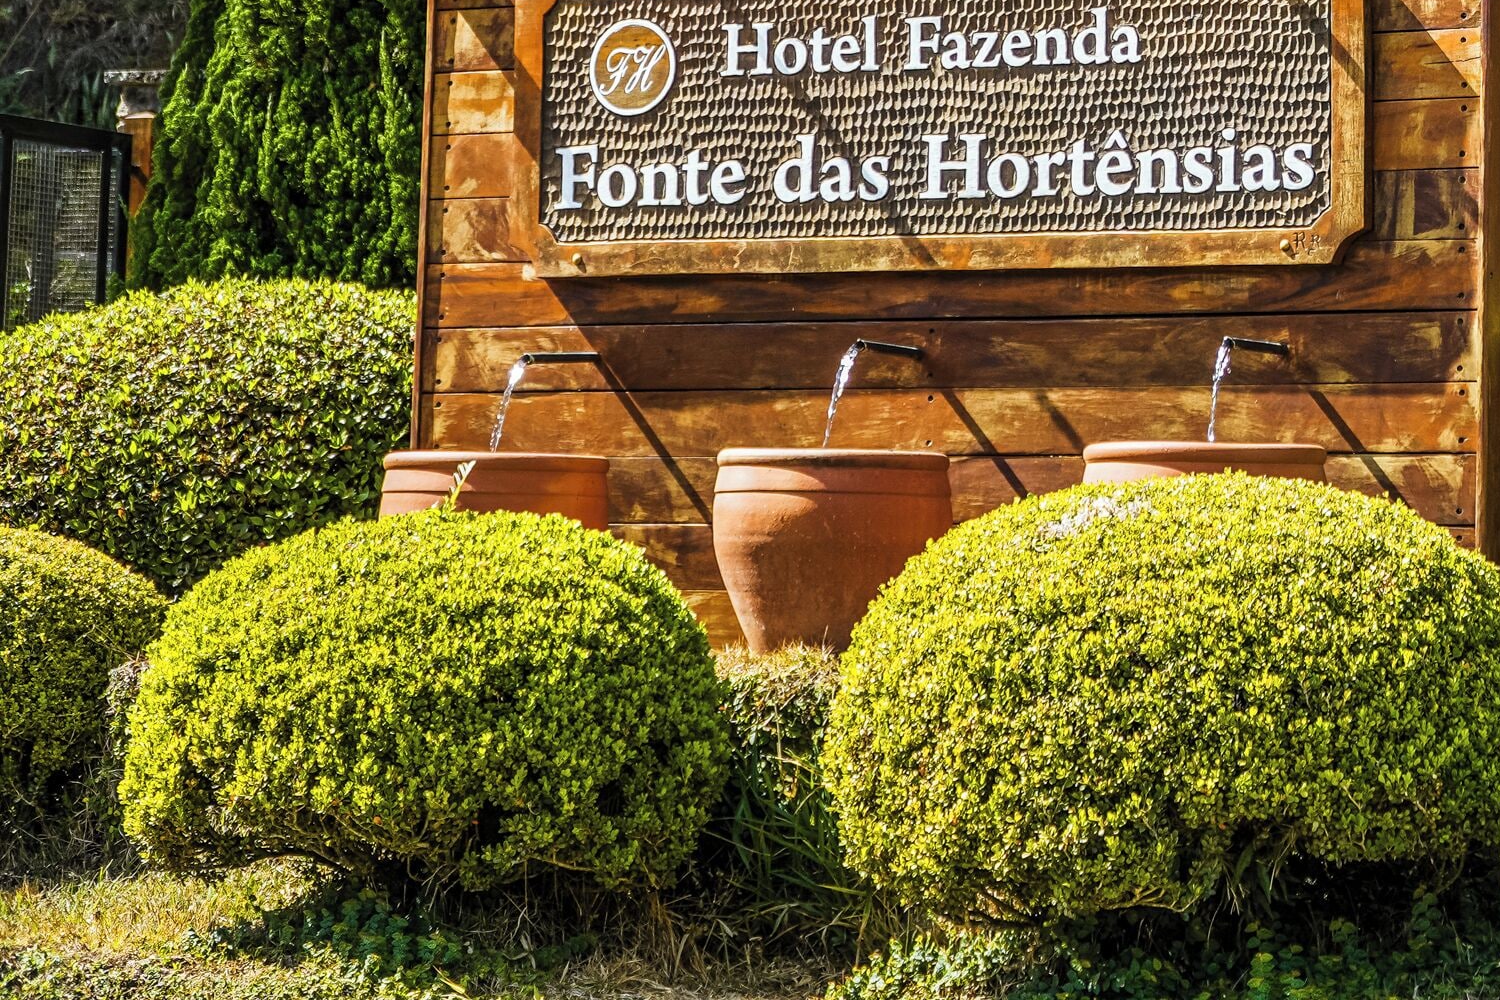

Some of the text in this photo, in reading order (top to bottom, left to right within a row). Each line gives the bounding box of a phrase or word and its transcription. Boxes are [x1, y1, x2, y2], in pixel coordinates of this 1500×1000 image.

[600, 44, 666, 96] FH
[721, 9, 1142, 77] Hotel Fazenda
[554, 128, 1316, 209] Fonte das Hortênsias
